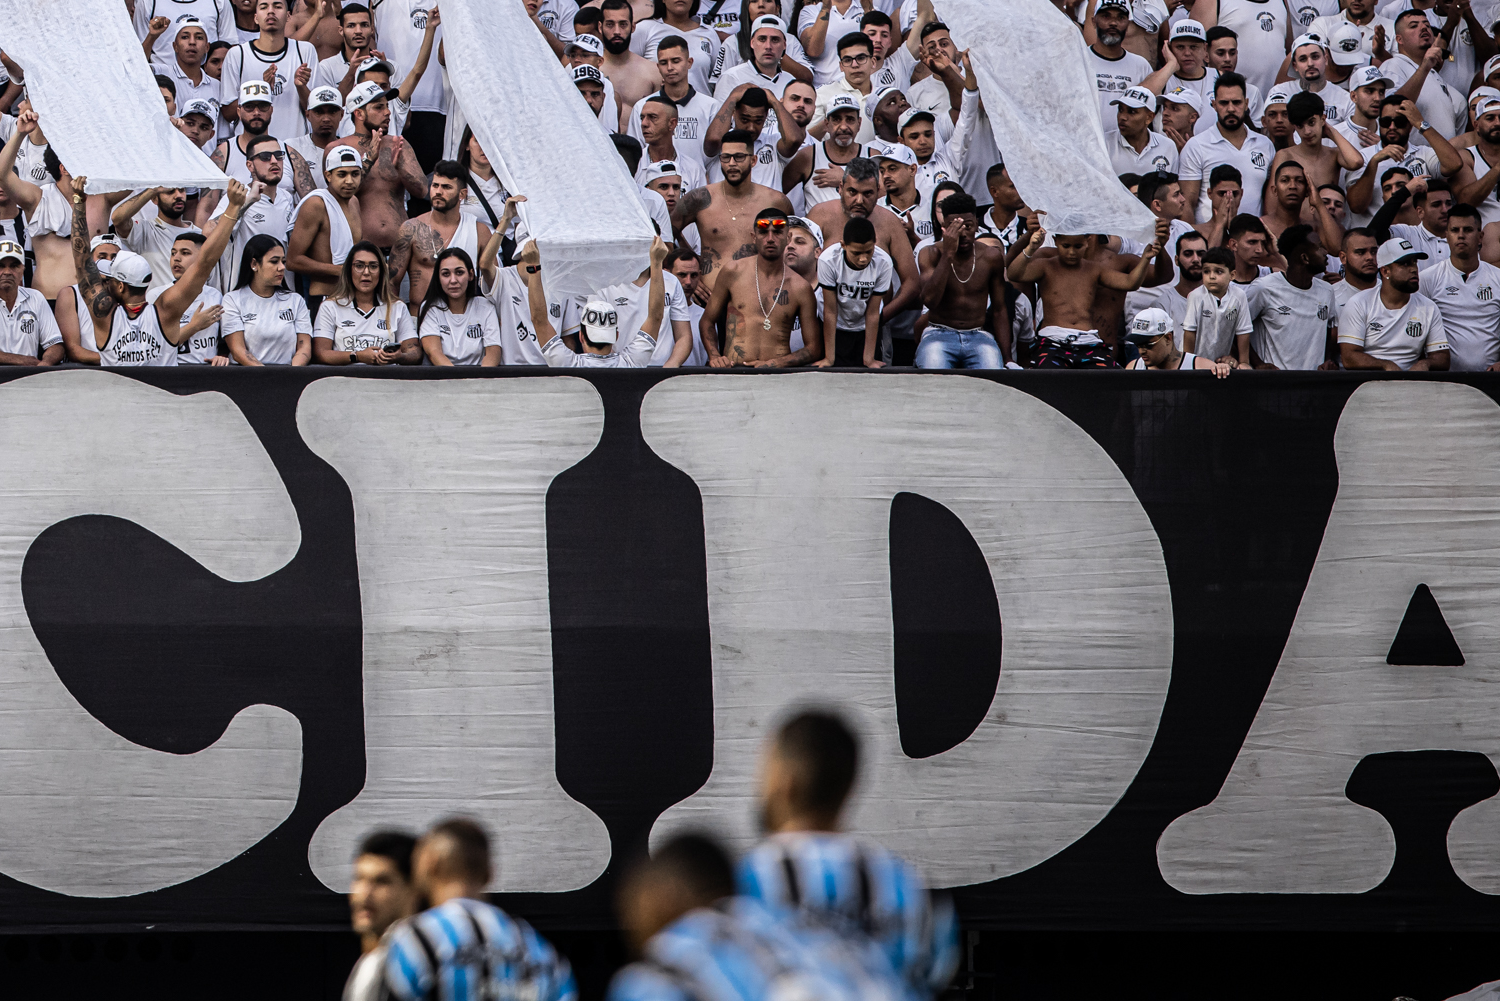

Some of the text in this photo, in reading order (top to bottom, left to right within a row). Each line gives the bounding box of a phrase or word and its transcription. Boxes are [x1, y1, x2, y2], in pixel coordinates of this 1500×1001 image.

[574, 35, 601, 49] VEM
[710, 46, 726, 79] Kicaldo
[573, 67, 601, 80] 1969
[242, 84, 269, 96] TJS
[837, 283, 875, 300] OVE
[111, 330, 161, 354] TORCIDA JOVEM
[116, 347, 158, 362] SANTOS F.C.
